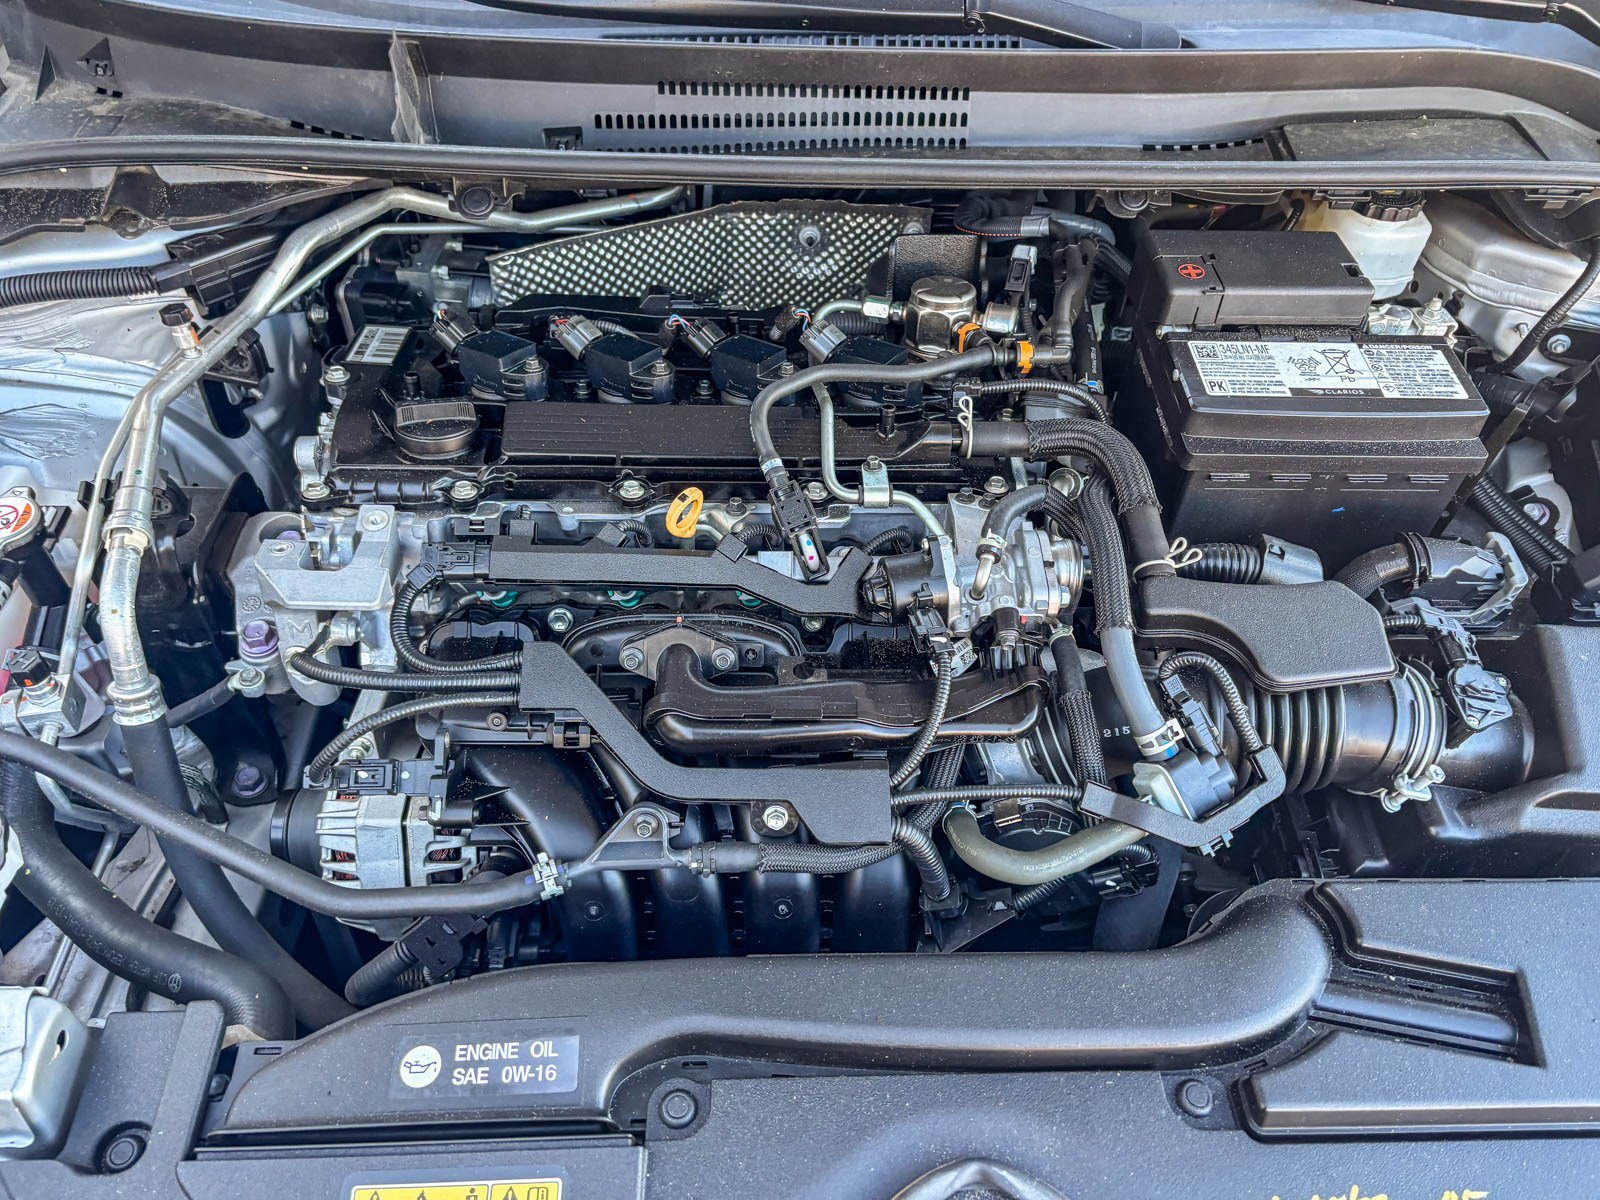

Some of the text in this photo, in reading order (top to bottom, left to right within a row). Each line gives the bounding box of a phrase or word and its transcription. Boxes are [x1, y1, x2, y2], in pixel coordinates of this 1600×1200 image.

[1219, 344, 1271, 355] 345LN1-MF
[1340, 375, 1356, 383] Pb
[1208, 380, 1227, 392] PK
[454, 1040, 559, 1062] ENGINE OIL
[451, 1064, 558, 1086] SAE 0W-16
